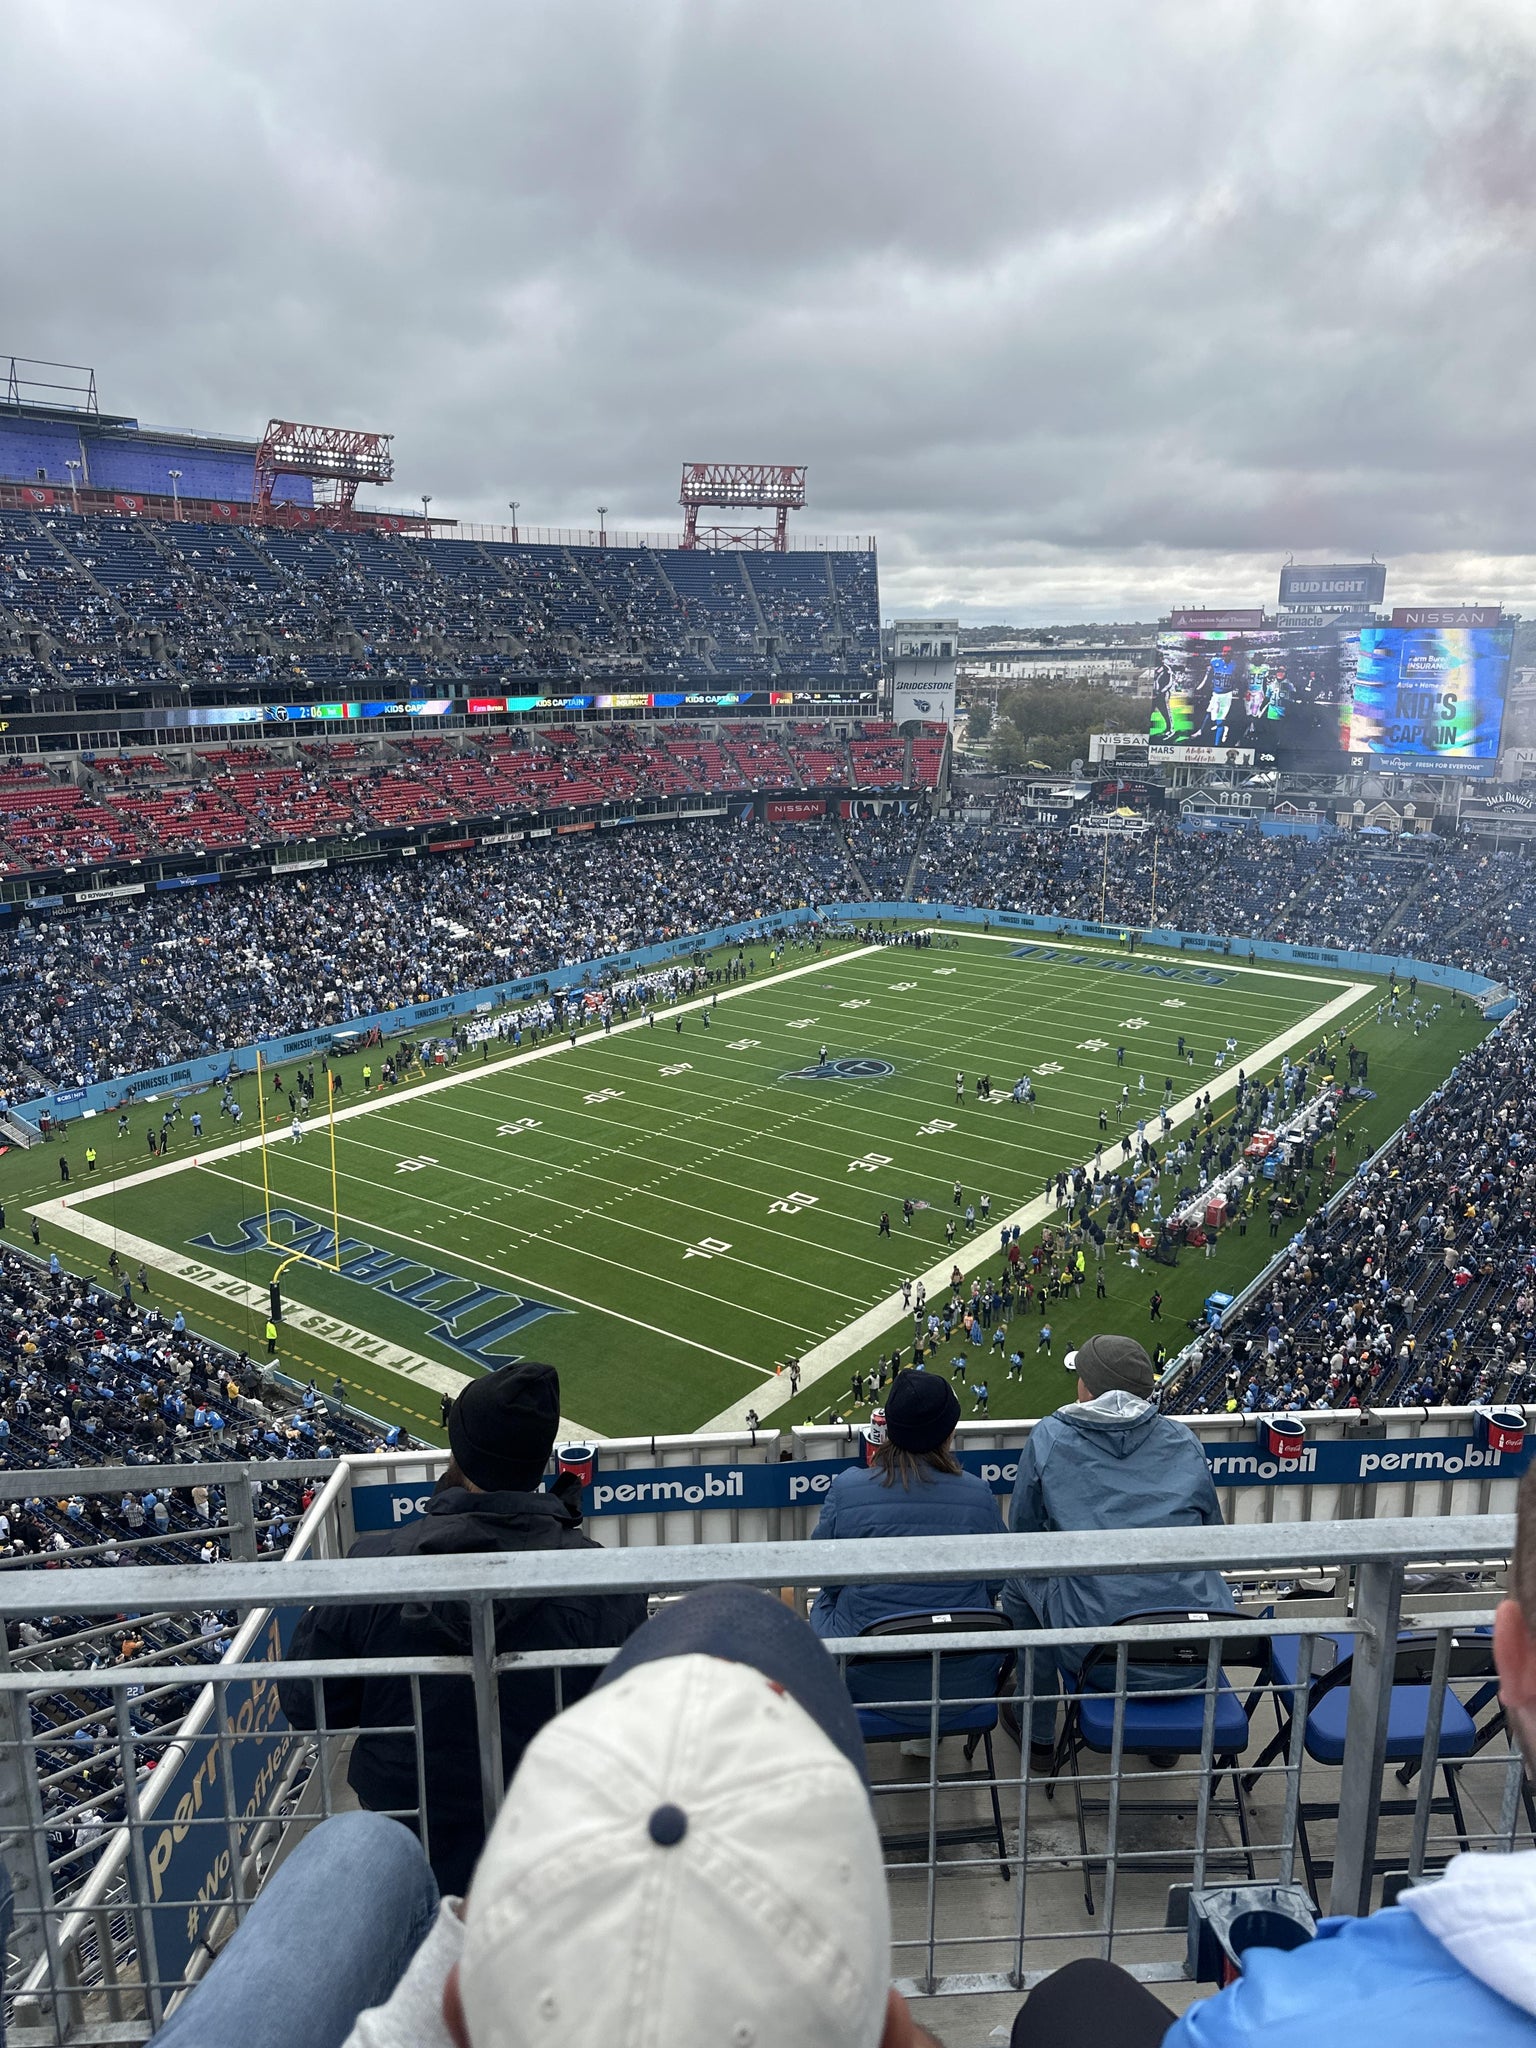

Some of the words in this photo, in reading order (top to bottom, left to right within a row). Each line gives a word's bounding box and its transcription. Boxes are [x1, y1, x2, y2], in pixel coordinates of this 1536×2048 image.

[1290, 582, 1320, 593] BUD
[1322, 581, 1364, 592] LIGHT
[1279, 615, 1323, 627] Pinnacle
[1406, 613, 1484, 623] NISSAN
[896, 681, 954, 690] BRIDGESTONE
[536, 699, 552, 707] KIDS
[553, 698, 584, 707] CAPTAIN
[705, 695, 739, 703] CAPTAIN
[300, 707, 322, 719] 2:06
[384, 705, 404, 713] KIDS
[1099, 736, 1149, 745] NISSAN
[1390, 757, 1412, 769] Kroger
[1486, 794, 1505, 806] JACK
[774, 804, 819, 812] NISSAN
[1038, 811, 1058, 823] lite
[1292, 949, 1319, 961] TENNESSEE
[1321, 953, 1339, 962] TOUGH
[1001, 943, 1239, 985] TITANS
[283, 1039, 313, 1053] TENNESSEE
[725, 1038, 762, 1051] 50
[658, 1062, 694, 1075] 40
[133, 1075, 168, 1092] TENNESSEE
[170, 1068, 191, 1082] TOUGH
[61, 1093, 71, 1101] CBS
[582, 1088, 626, 1103] 30
[496, 1117, 544, 1135] 20
[920, 1118, 958, 1135] 40
[395, 1155, 439, 1172] 10
[848, 1152, 894, 1172] 30
[768, 1191, 820, 1214] 20
[685, 1237, 733, 1259] 10
[177, 1264, 217, 1283] US
[183, 1208, 580, 1372] TITANS
[211, 1280, 252, 1297] OF
[251, 1292, 305, 1317] AL
[299, 1315, 389, 1359] TAKES
[387, 1360, 428, 1374] IT
[873, 1428, 881, 1443] ULY
[1206, 1447, 1317, 1479] rmobil
[1359, 1444, 1500, 1477] permobil
[594, 1471, 743, 1510] permobil
[127, 1686, 139, 1697] 22
